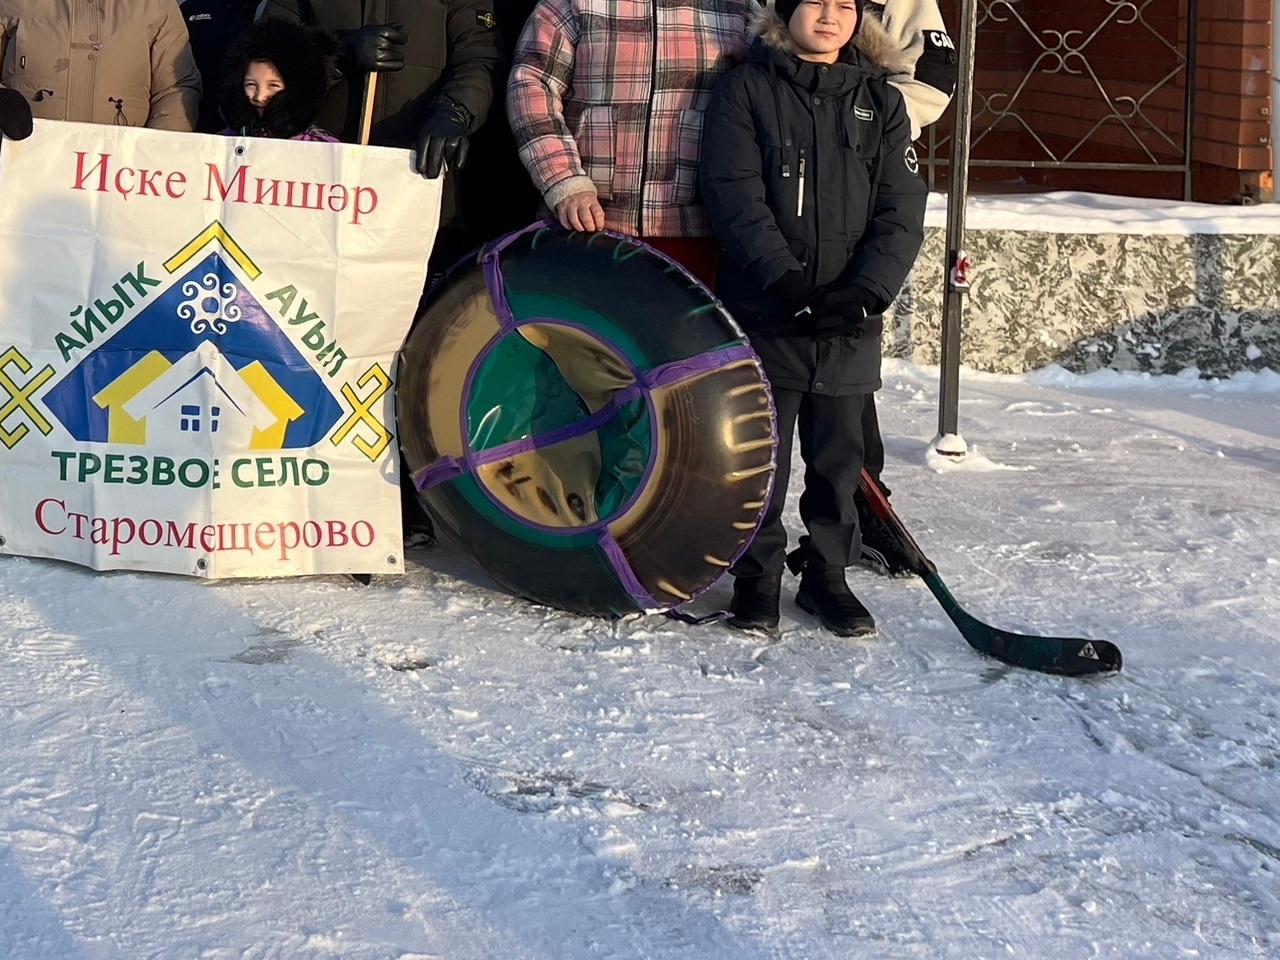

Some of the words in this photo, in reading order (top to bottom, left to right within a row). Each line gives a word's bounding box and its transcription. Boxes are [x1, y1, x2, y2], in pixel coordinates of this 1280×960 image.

[70, 151, 188, 201] Иҫке
[202, 162, 379, 226] Мишәр
[265, 283, 348, 379] АУЫЛ
[231, 457, 331, 488] СЕЛО
[34, 498, 376, 561] Старомещерово
